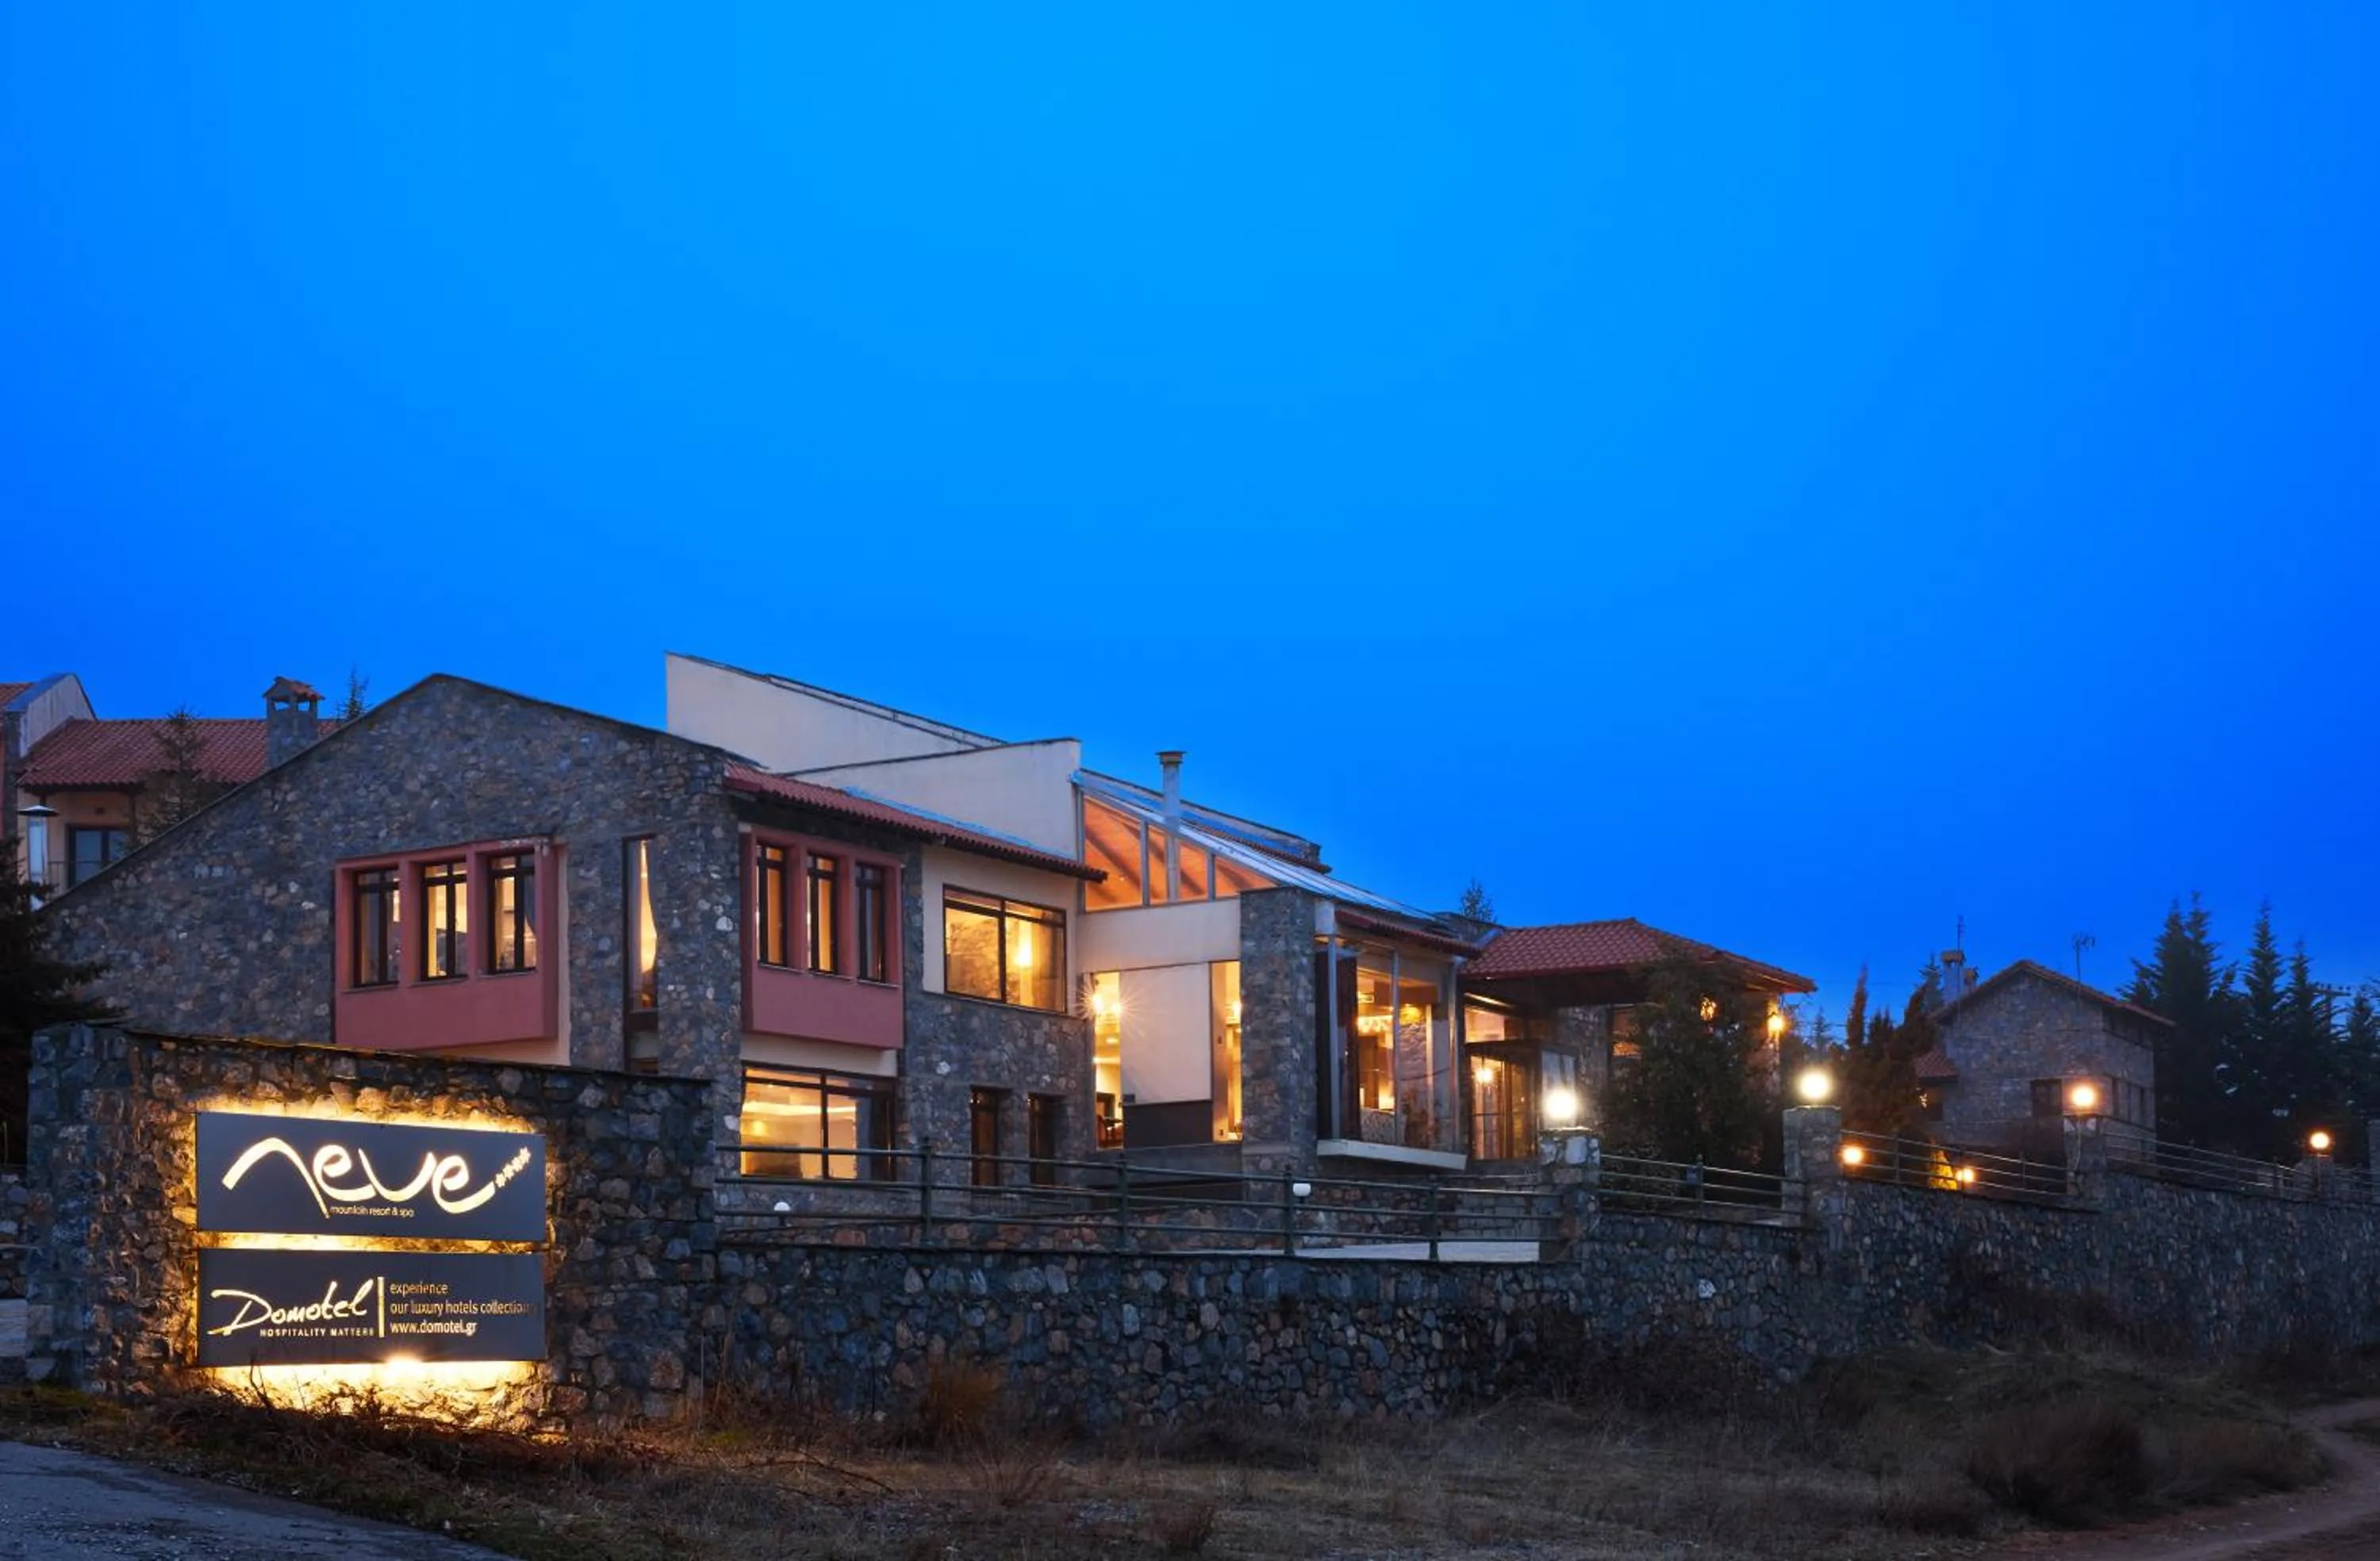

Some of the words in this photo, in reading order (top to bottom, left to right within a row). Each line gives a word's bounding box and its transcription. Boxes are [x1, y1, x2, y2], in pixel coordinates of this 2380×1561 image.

[369, 1206, 391, 1216] resort
[392, 1206, 398, 1216] &
[399, 1208, 414, 1218] spa
[390, 1281, 449, 1298] experience
[207, 1278, 374, 1336] Domotel
[390, 1302, 408, 1314] our
[410, 1299, 443, 1317] luxury
[445, 1298, 478, 1314] hotels
[259, 1328, 326, 1337] HOSPITALITY
[330, 1328, 374, 1337] MATTERS
[390, 1319, 478, 1337] www.domotel.gr
